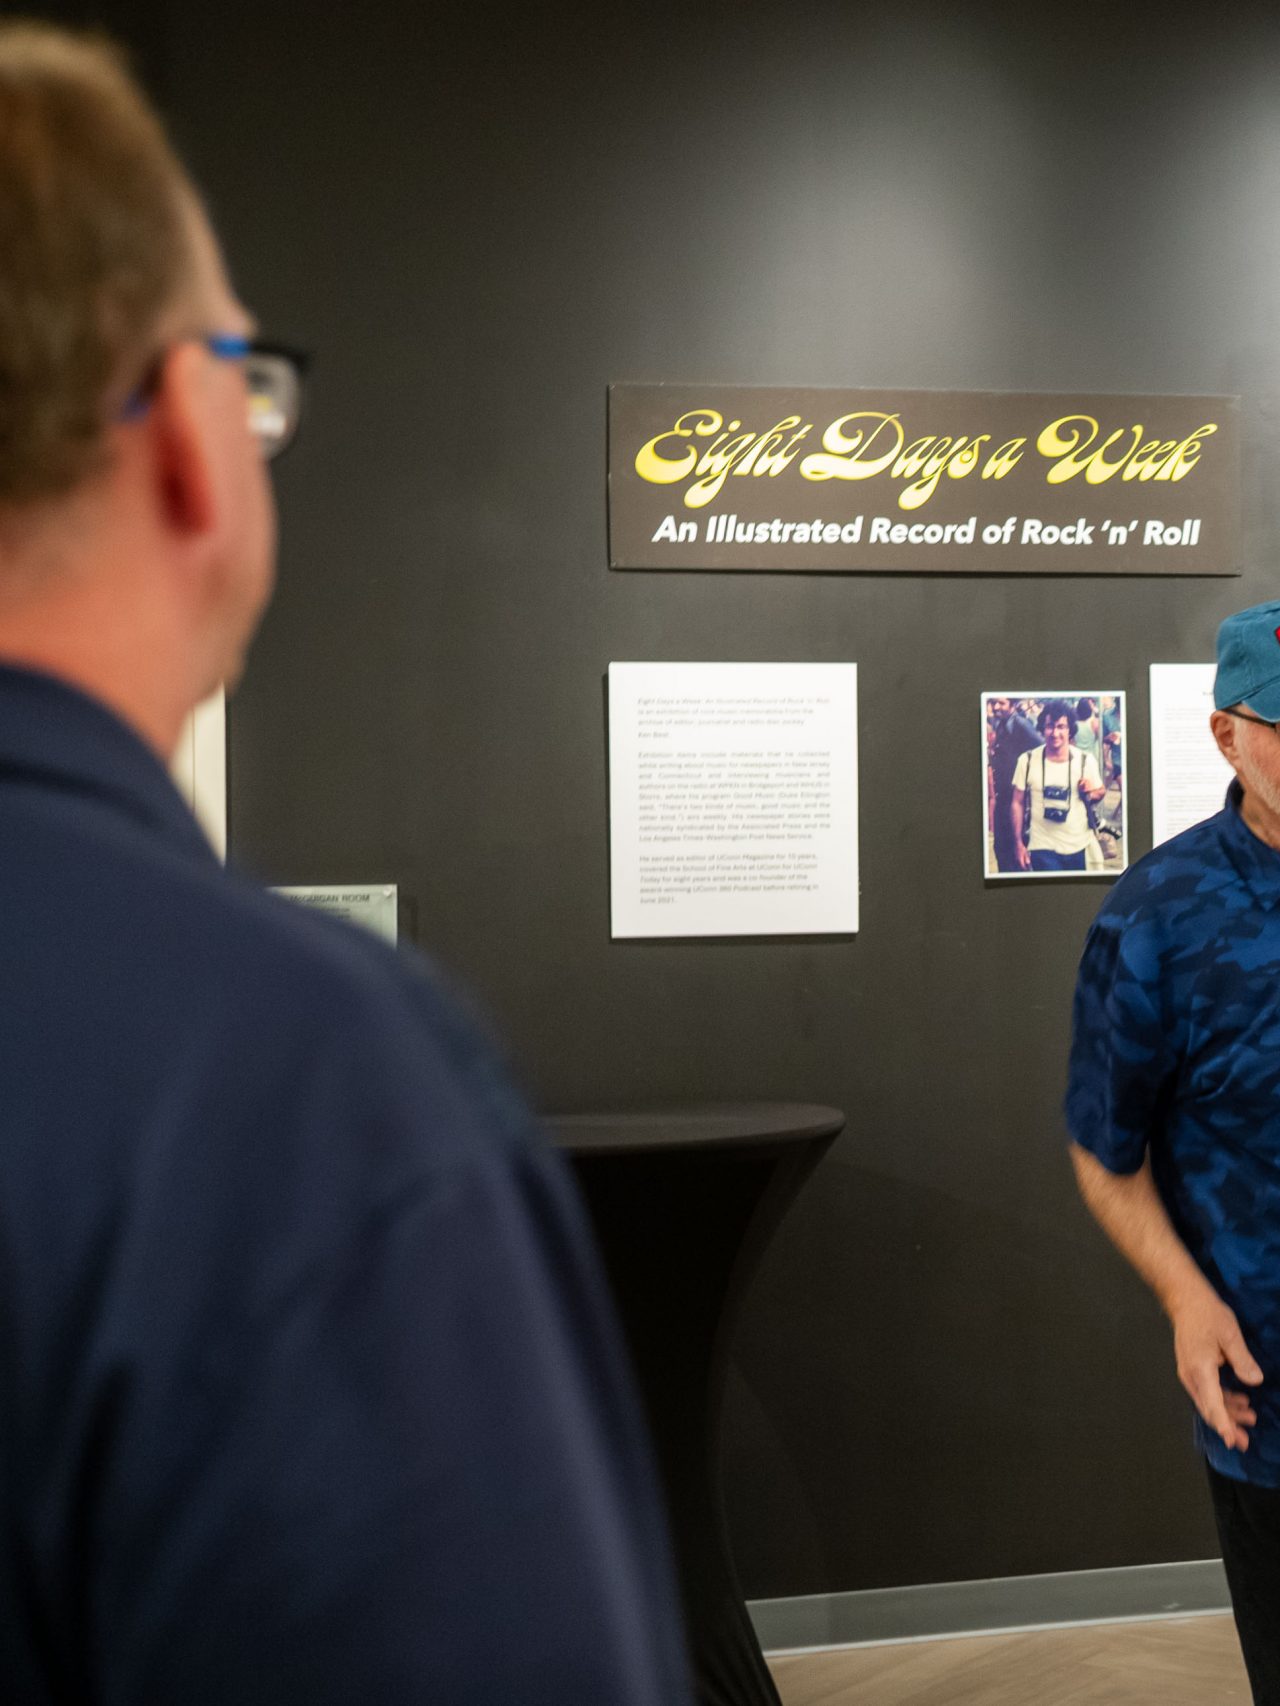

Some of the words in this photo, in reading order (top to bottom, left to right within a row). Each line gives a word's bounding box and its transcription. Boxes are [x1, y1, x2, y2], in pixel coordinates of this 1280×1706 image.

[635, 408, 812, 508] Eight
[800, 411, 989, 511] Days
[982, 437, 1026, 479] a
[1037, 415, 1218, 485] Week
[652, 516, 696, 543] An
[707, 517, 861, 544] Illustrated
[871, 518, 975, 544] Record
[982, 518, 1015, 545] of
[1023, 520, 1093, 545] Rock
[1144, 521, 1200, 547] Roll
[342, 894, 370, 902] ROOM
